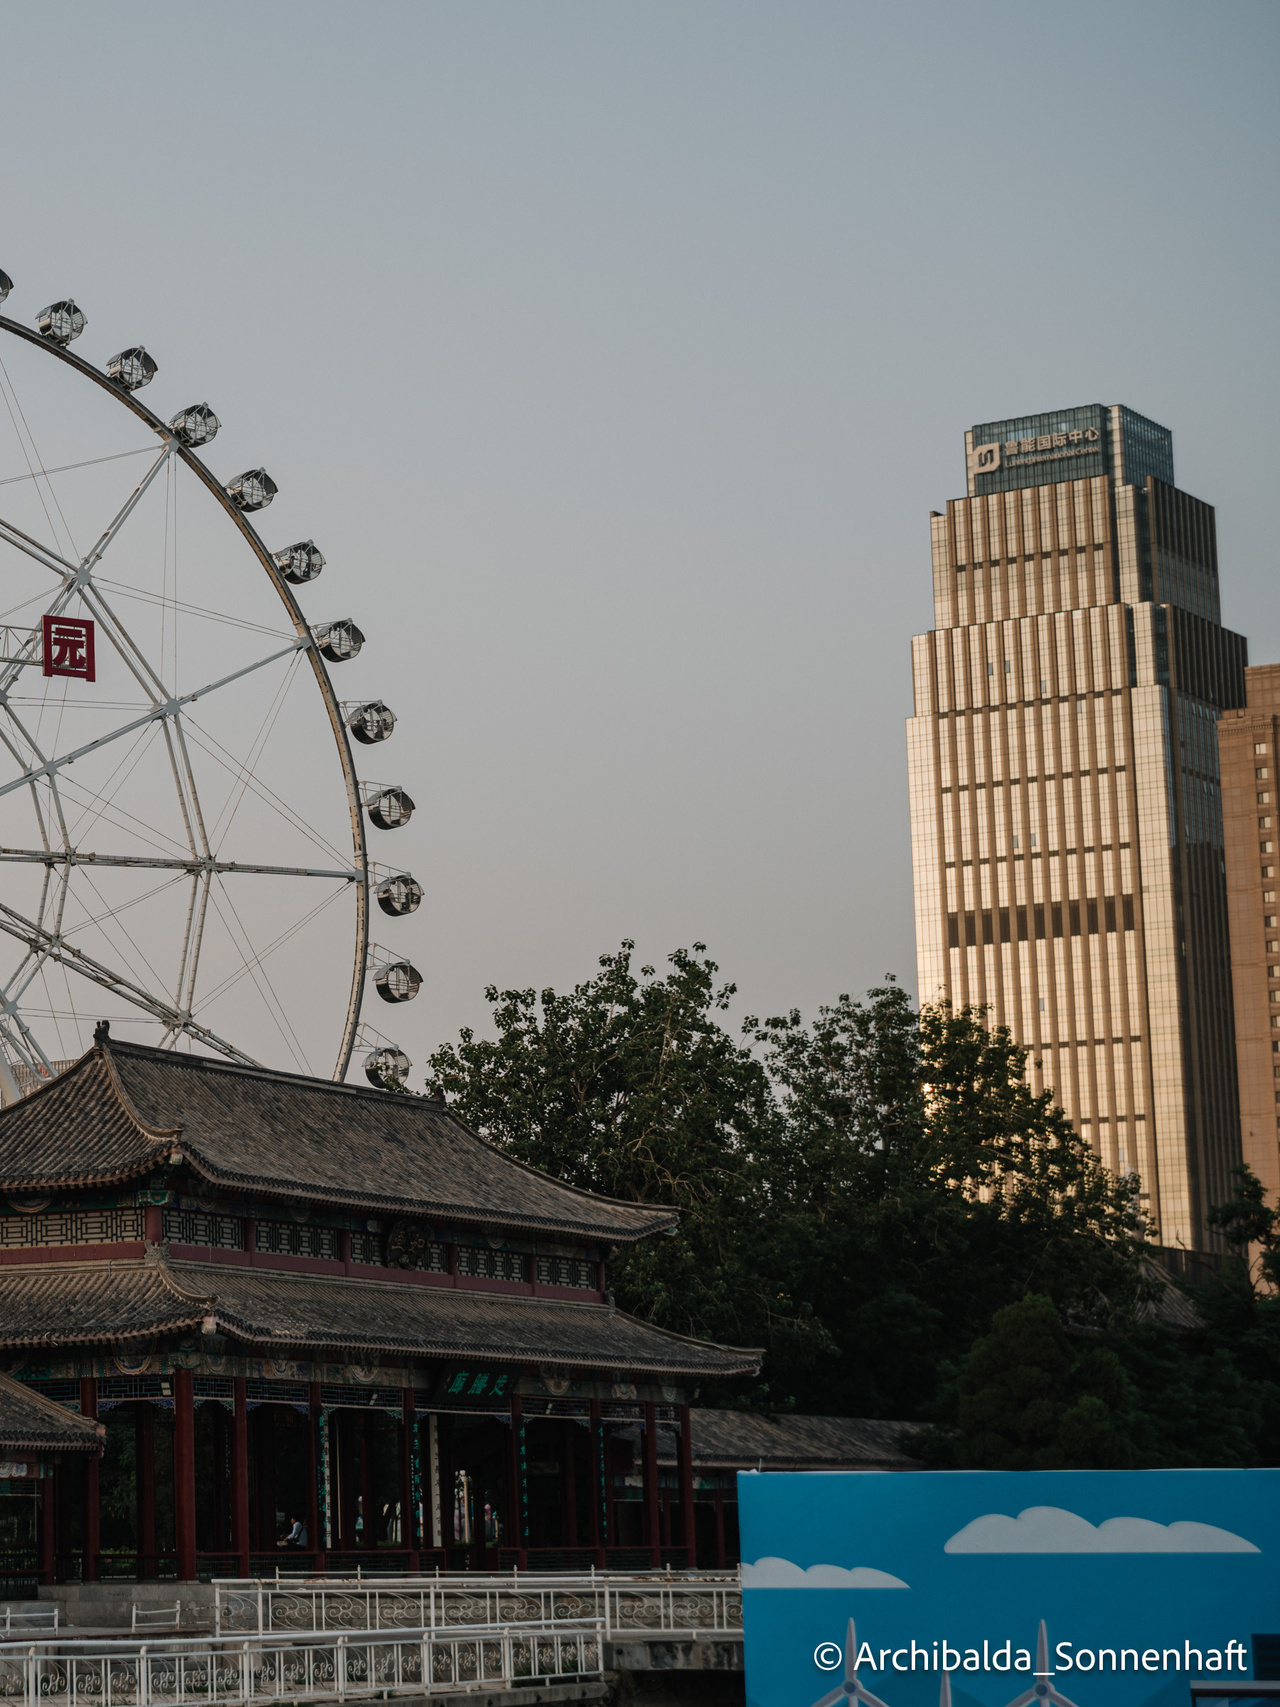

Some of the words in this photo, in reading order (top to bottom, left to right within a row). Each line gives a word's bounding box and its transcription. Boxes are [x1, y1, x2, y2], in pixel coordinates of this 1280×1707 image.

[1005, 426, 1099, 456] 鲁能国际中心
[1004, 457, 1032, 468] Luneng
[1032, 449, 1075, 463] International
[1075, 446, 1100, 456] Center
